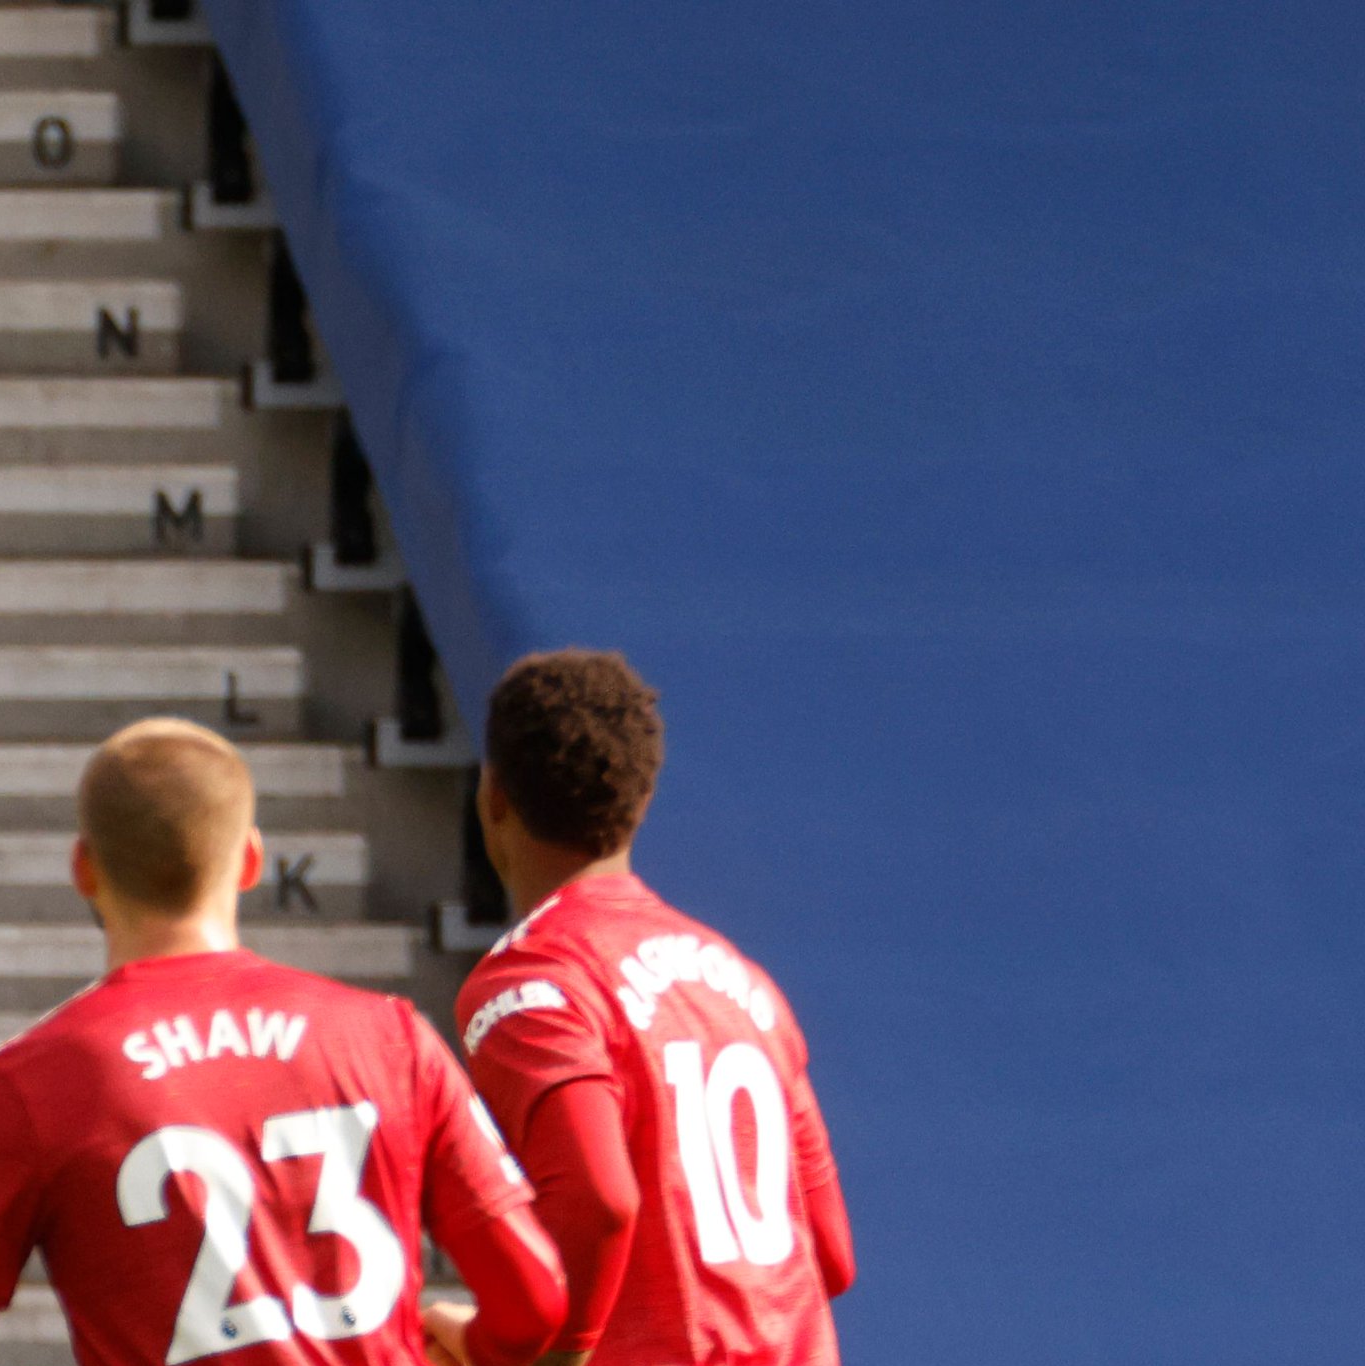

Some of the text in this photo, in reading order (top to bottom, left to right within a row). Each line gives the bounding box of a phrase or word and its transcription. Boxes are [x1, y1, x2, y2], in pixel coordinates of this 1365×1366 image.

[98, 307, 139, 361] N
[153, 488, 204, 542] M
[223, 669, 259, 725] L
[277, 855, 318, 911] K
[121, 1006, 307, 1080] SHAW
[663, 1040, 794, 1266] 10
[116, 1100, 406, 1366] 23
